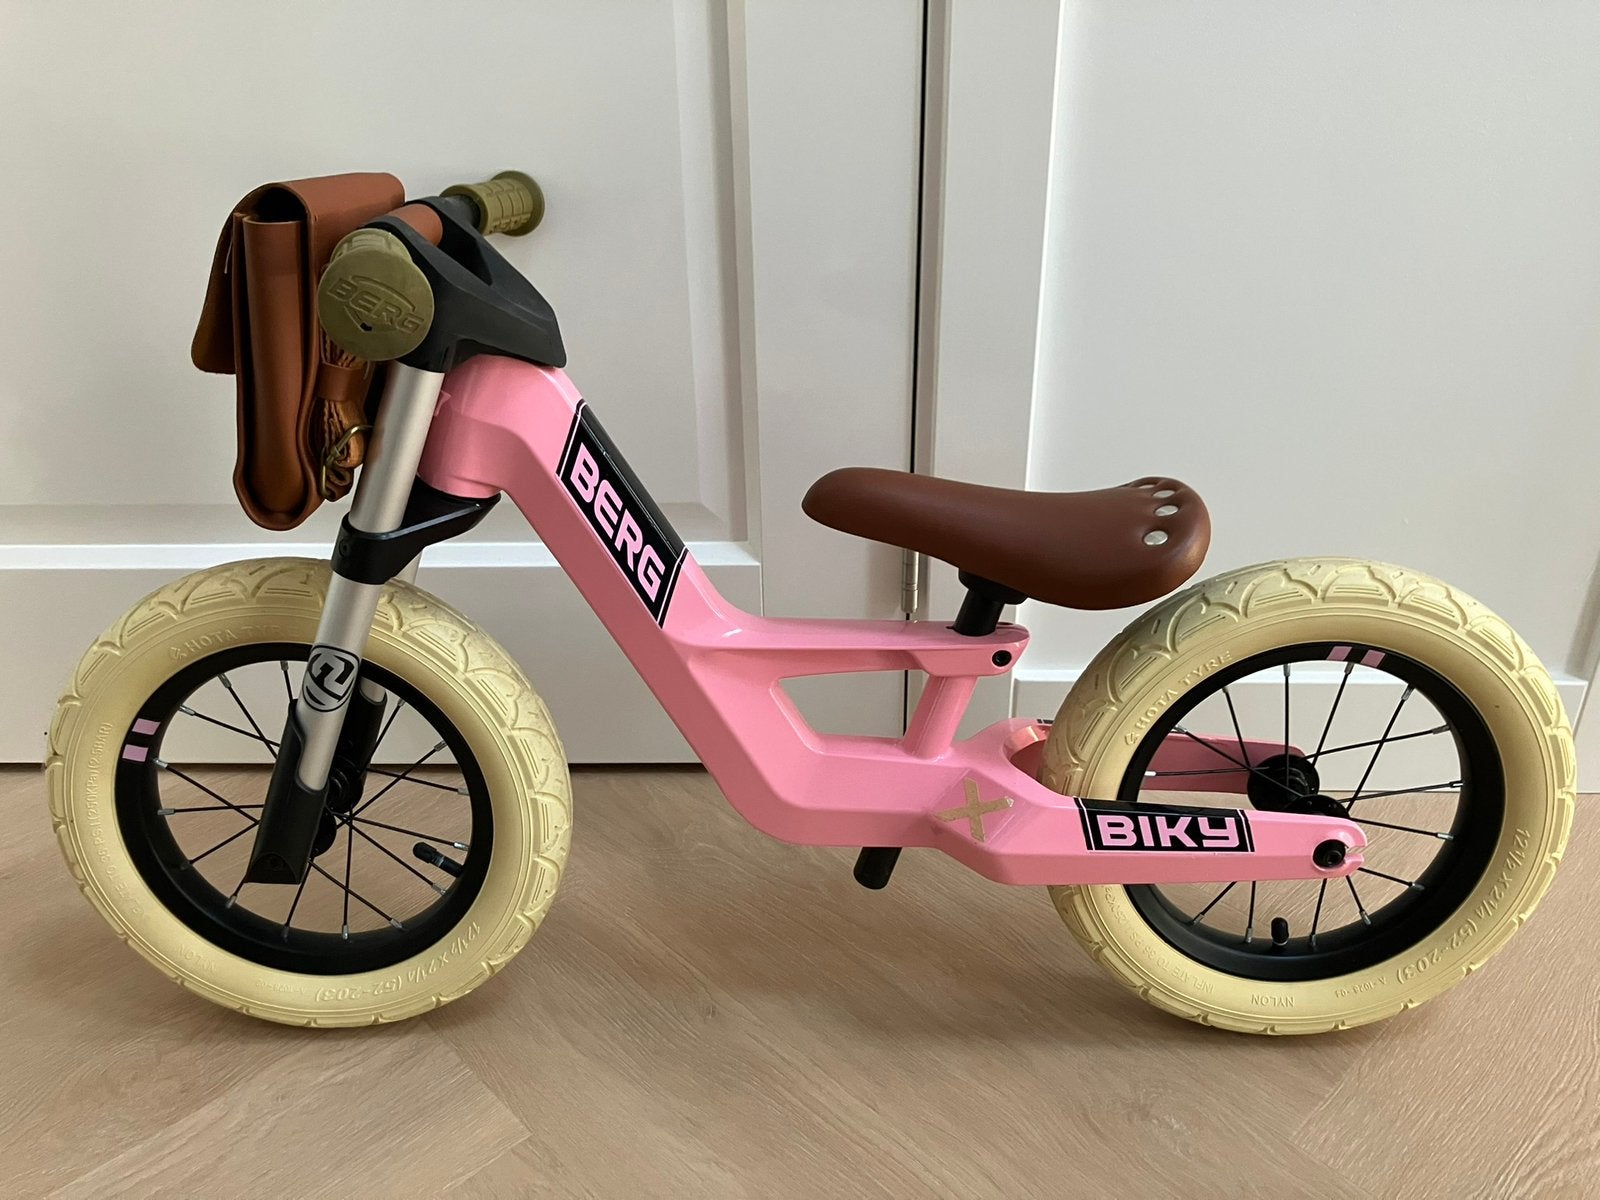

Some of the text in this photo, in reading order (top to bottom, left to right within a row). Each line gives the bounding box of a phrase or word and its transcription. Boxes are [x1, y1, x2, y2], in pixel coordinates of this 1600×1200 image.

[326, 278, 424, 334] BERG
[570, 442, 666, 603] BERG
[184, 629, 239, 652] HOTA
[1135, 650, 1232, 729] HOTA TYRE
[1096, 814, 1240, 848] BIKY
[1396, 918, 1478, 984] (52-203)
[1251, 993, 1295, 1008] NYLON
